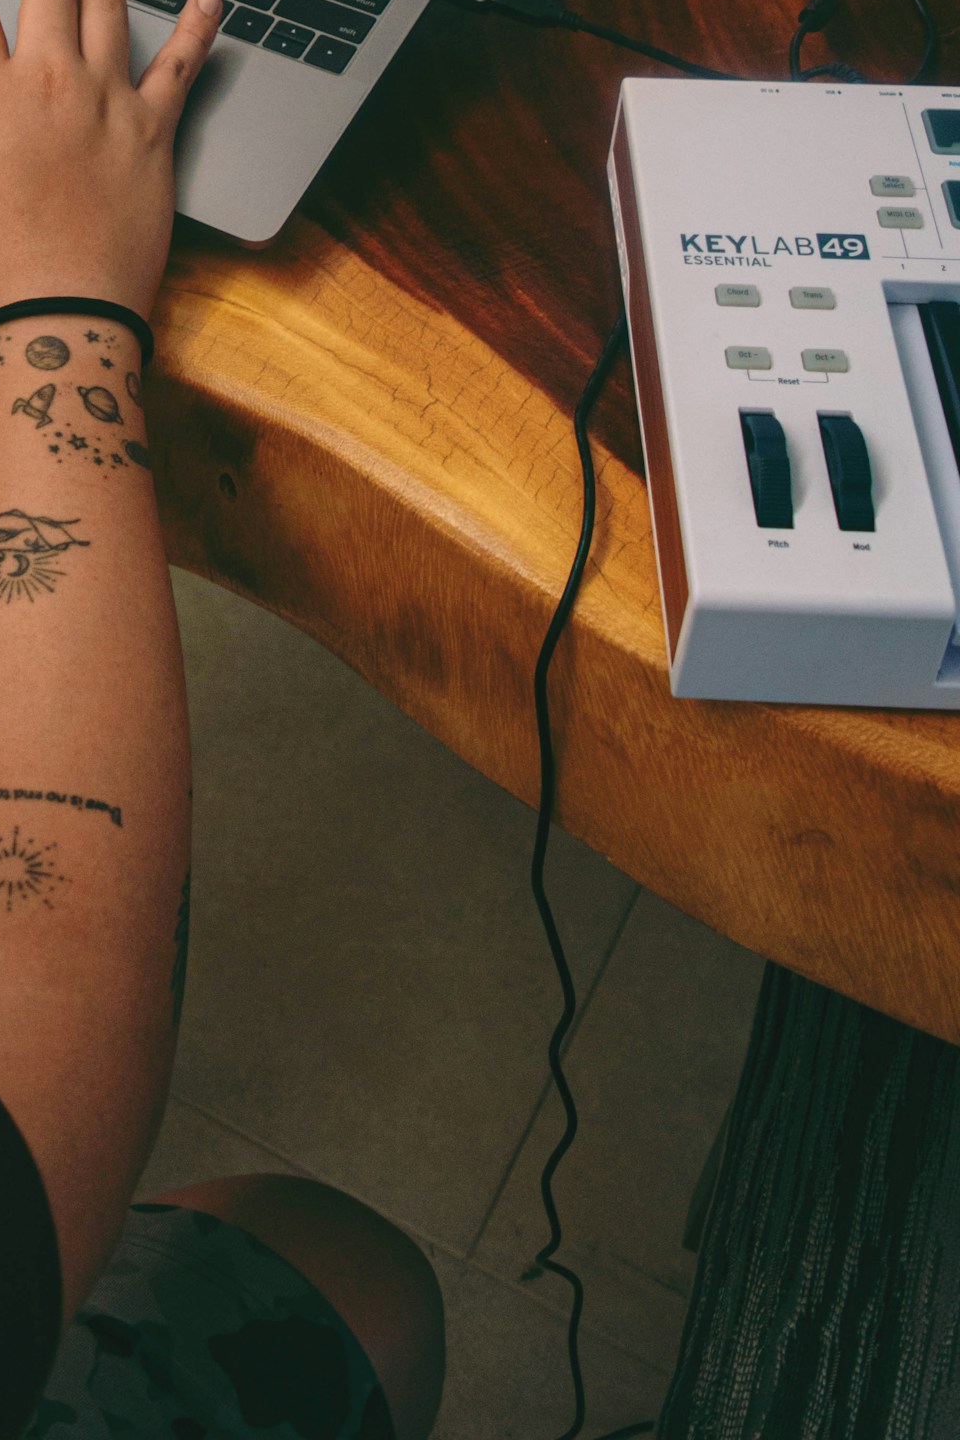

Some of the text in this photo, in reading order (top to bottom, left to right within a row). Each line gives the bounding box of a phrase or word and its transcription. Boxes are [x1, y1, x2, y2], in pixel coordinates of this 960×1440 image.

[884, 176, 900, 184] Map
[882, 181, 905, 189] Select
[887, 210, 903, 218] MIDI
[680, 233, 865, 258] KEYLAB 49
[683, 255, 772, 267] ESSENTIAL
[726, 287, 749, 296] Chord
[802, 290, 823, 299] Trans
[777, 377, 800, 385] Reset
[767, 539, 790, 548] Pitch
[852, 542, 871, 551] Mod
